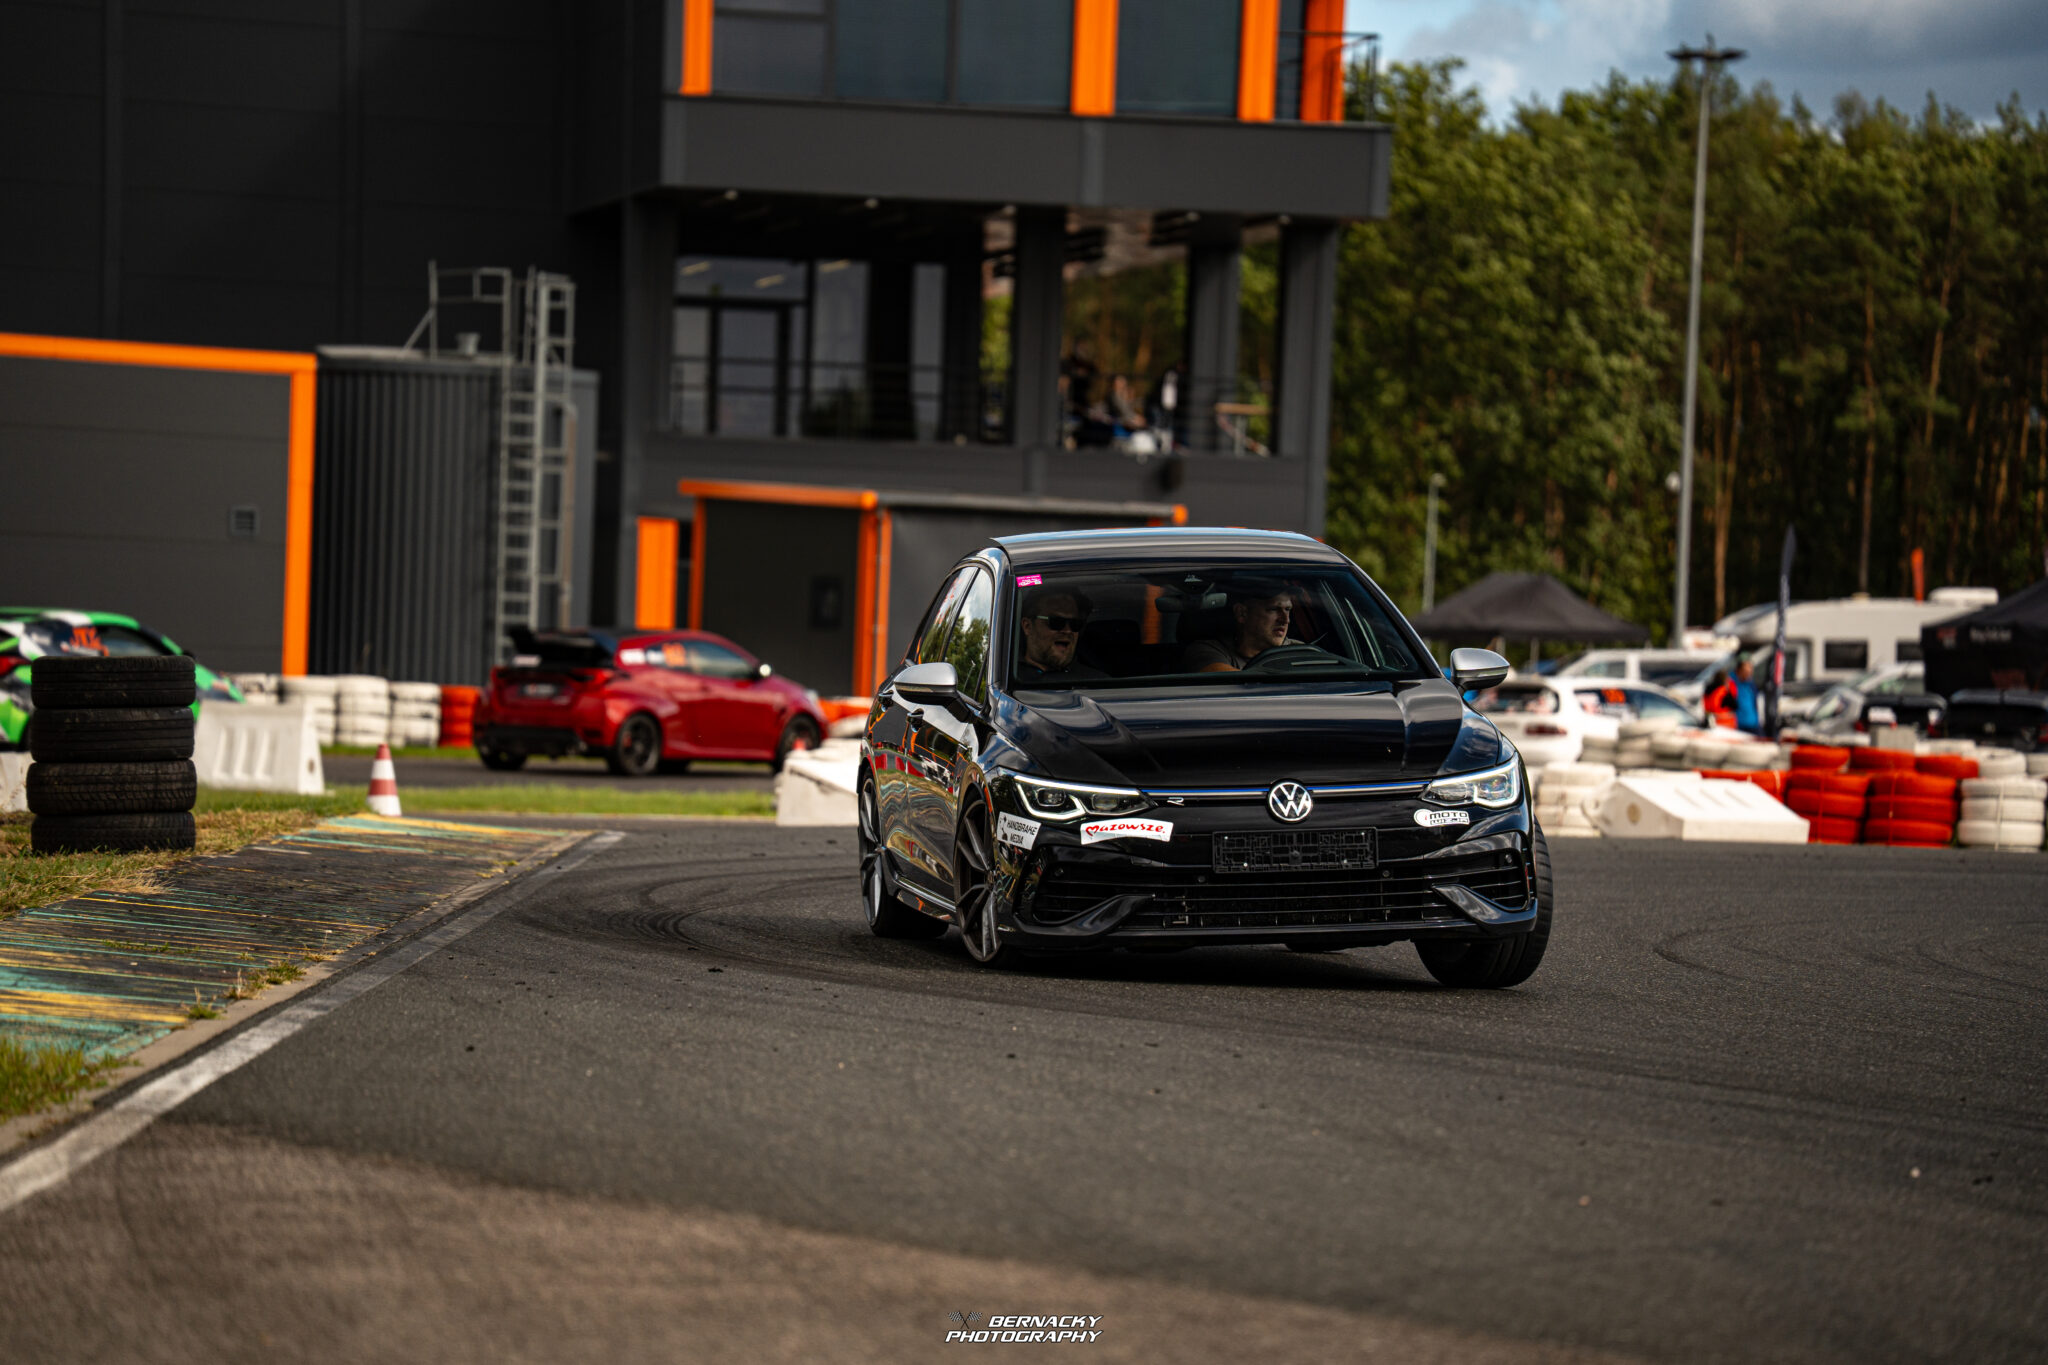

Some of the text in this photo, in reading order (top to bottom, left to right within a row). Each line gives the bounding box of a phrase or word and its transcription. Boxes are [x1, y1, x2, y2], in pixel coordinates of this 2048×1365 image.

[1269, 782, 1312, 821] VW
[1007, 820, 1038, 836] HANDBRAKE
[1009, 833, 1024, 845] MEDIA
